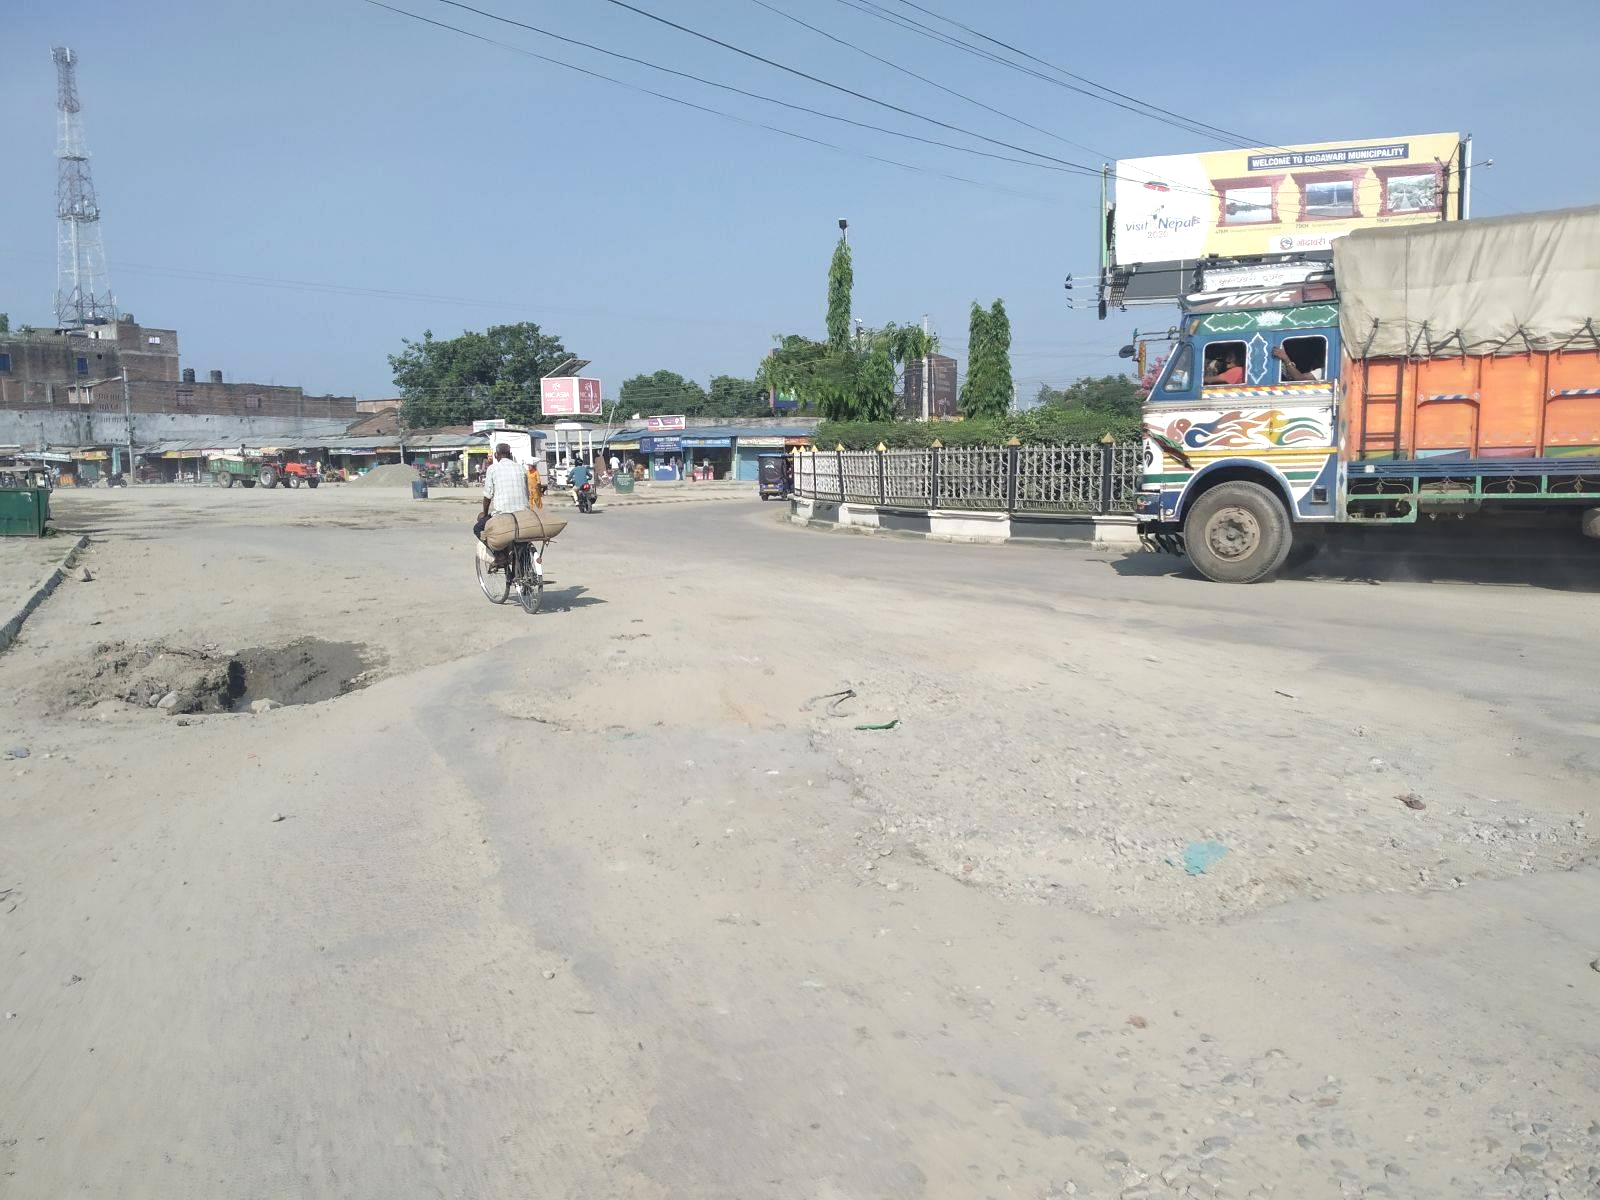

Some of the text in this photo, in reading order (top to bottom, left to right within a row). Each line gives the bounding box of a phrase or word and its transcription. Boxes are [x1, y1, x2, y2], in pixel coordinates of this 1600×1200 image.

[1252, 147, 1404, 167] WELCOME TO GODAWARI MUNICIPALITY
[1125, 216, 1194, 232] visit Nepal
[1147, 230, 1169, 239] 2020
[1214, 290, 1298, 307] NIKE
